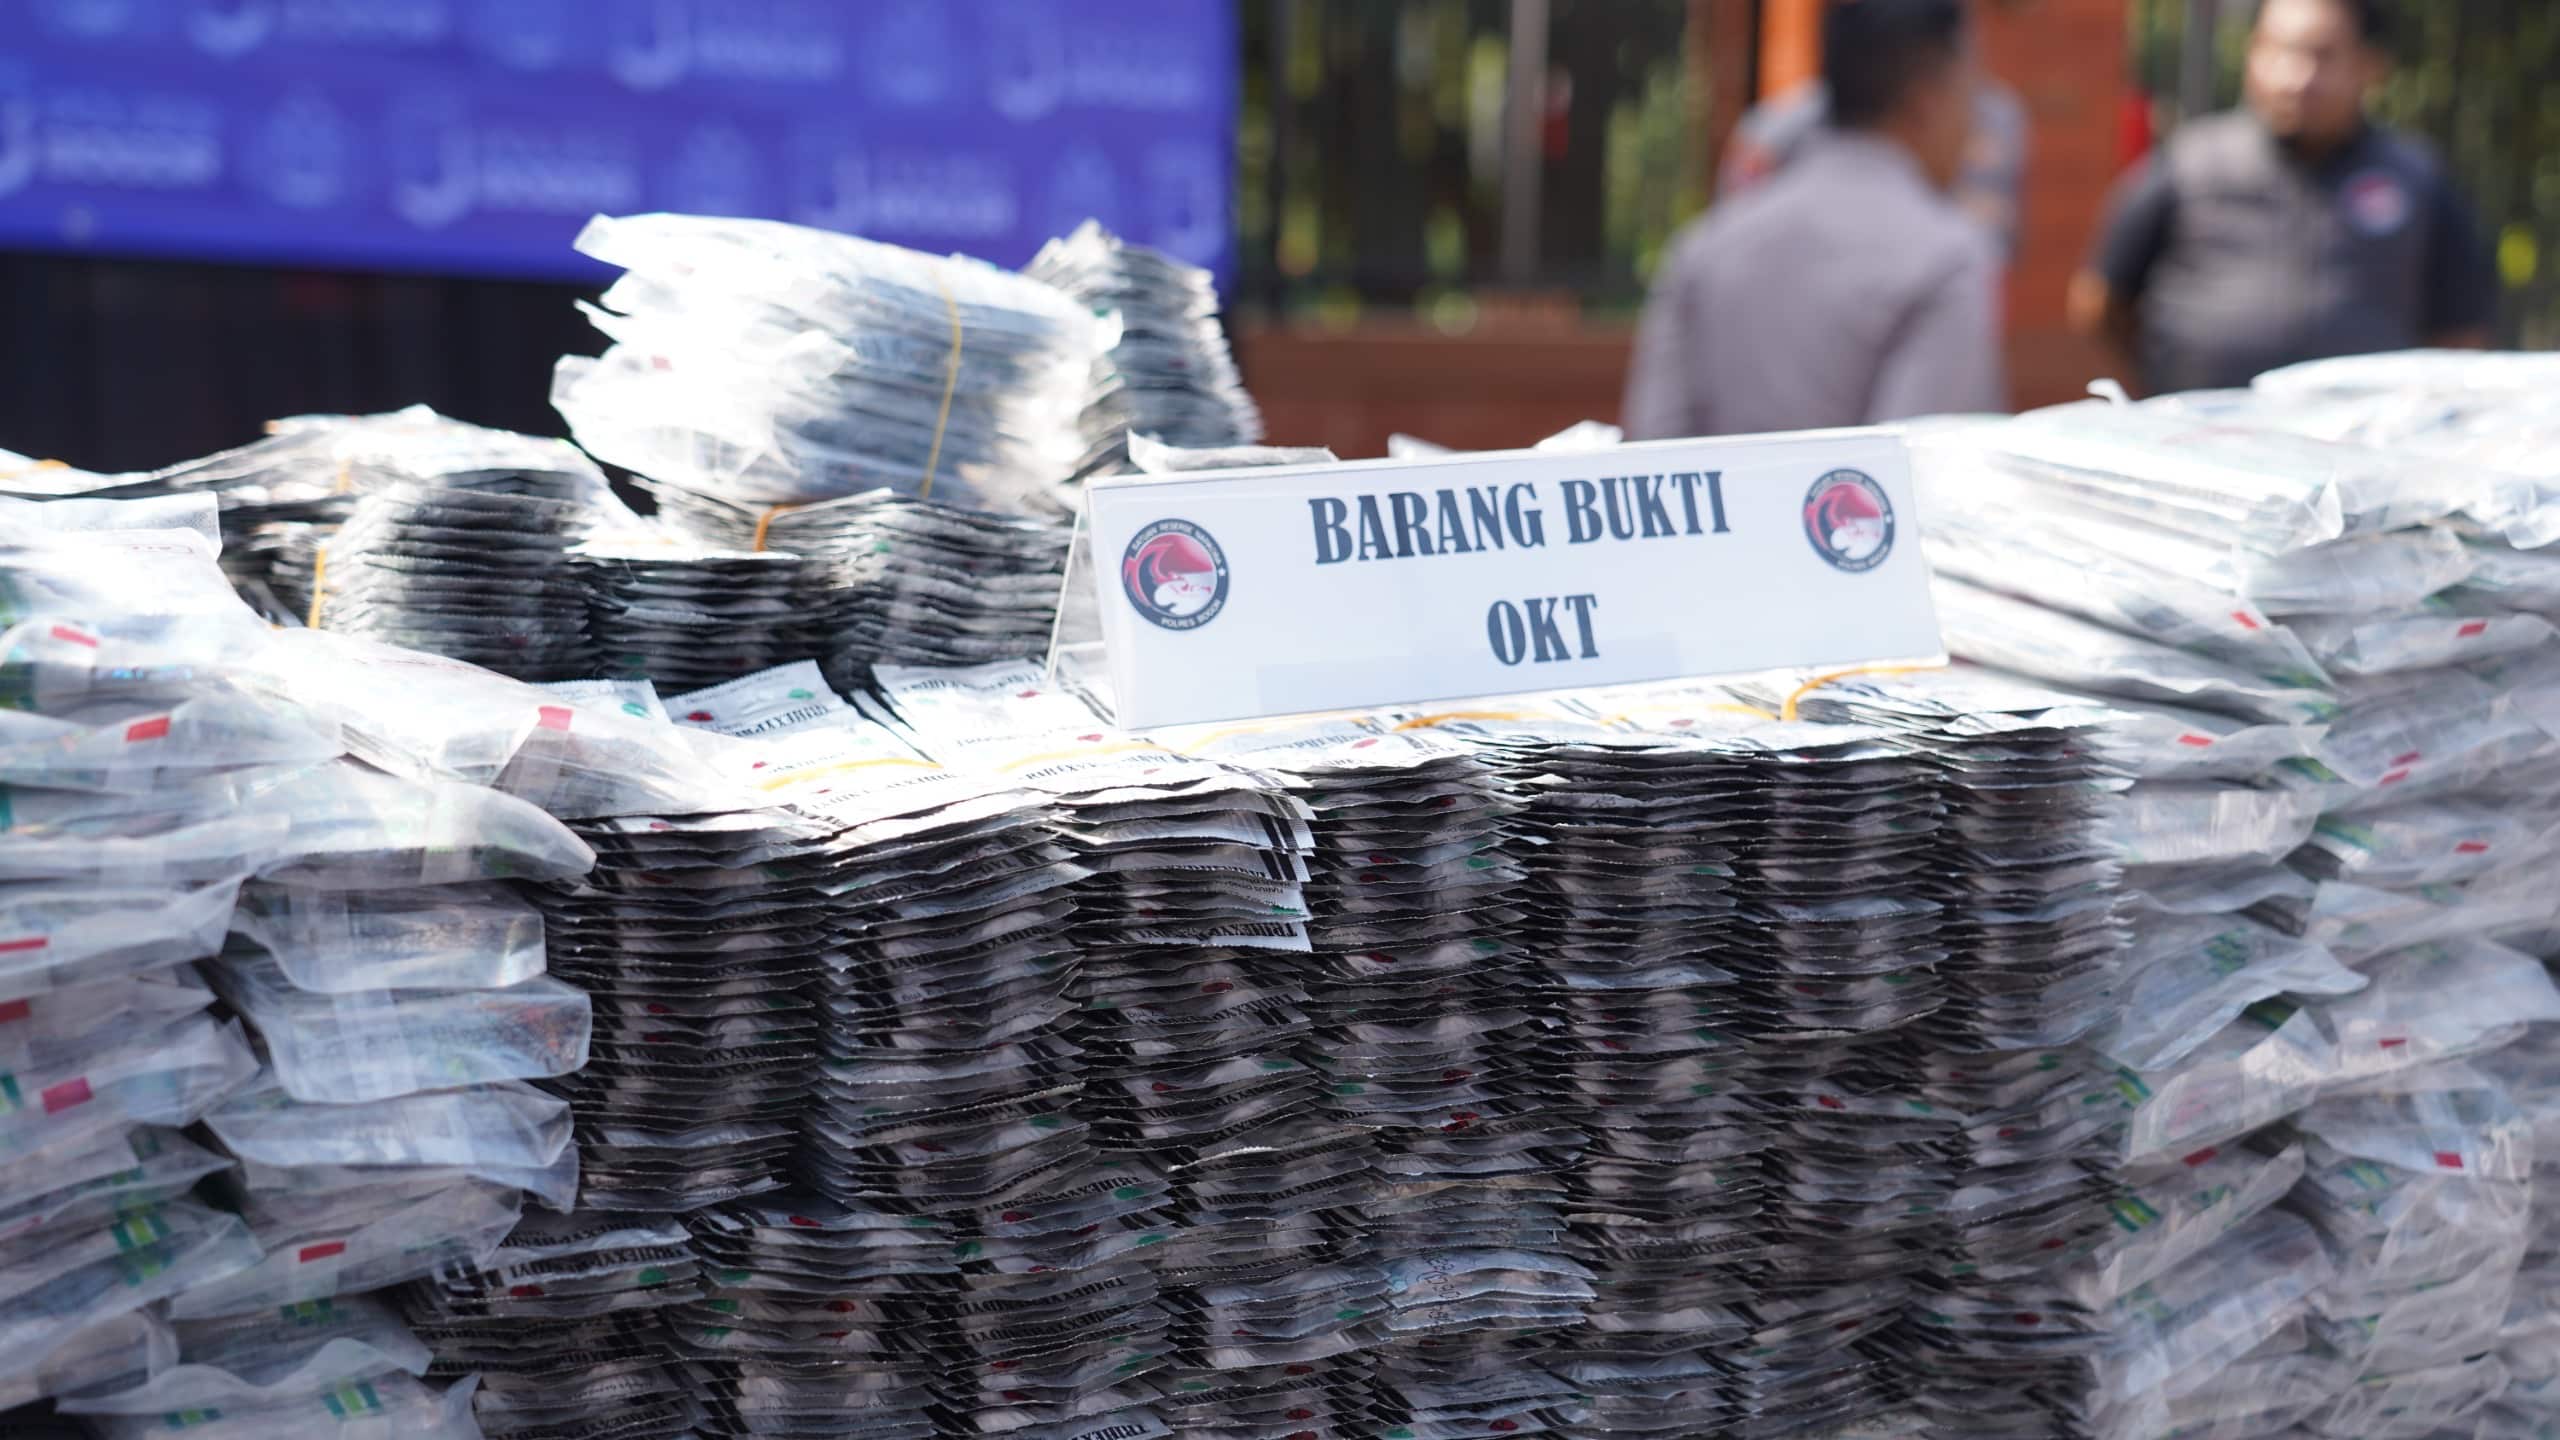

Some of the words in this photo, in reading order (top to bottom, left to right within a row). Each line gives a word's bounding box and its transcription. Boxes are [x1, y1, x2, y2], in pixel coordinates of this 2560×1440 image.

[1308, 483, 1545, 565] BARANG
[1560, 471, 1731, 543] BUKTI
[1487, 594, 1600, 666] OKT
